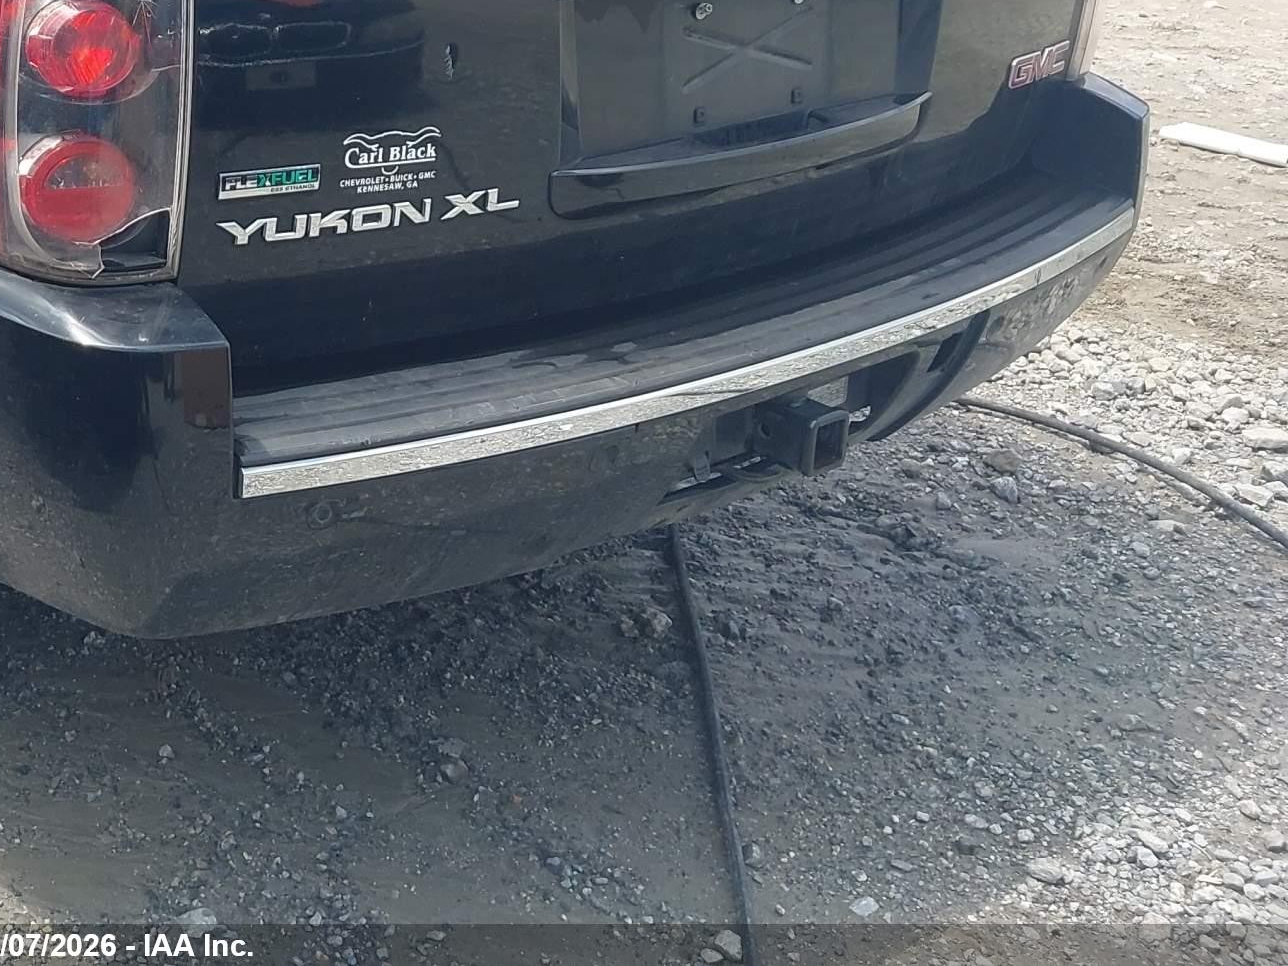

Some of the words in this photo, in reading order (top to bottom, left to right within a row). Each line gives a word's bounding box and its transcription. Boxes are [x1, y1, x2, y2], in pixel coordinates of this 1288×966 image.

[1008, 40, 1071, 90] GMC
[344, 146, 384, 169] Carl
[389, 143, 437, 161] Black
[339, 176, 385, 187] CHEVROLET
[418, 170, 437, 180] GMC
[406, 180, 419, 189] GA
[216, 198, 433, 246] YUKON
[441, 188, 521, 220] XL
